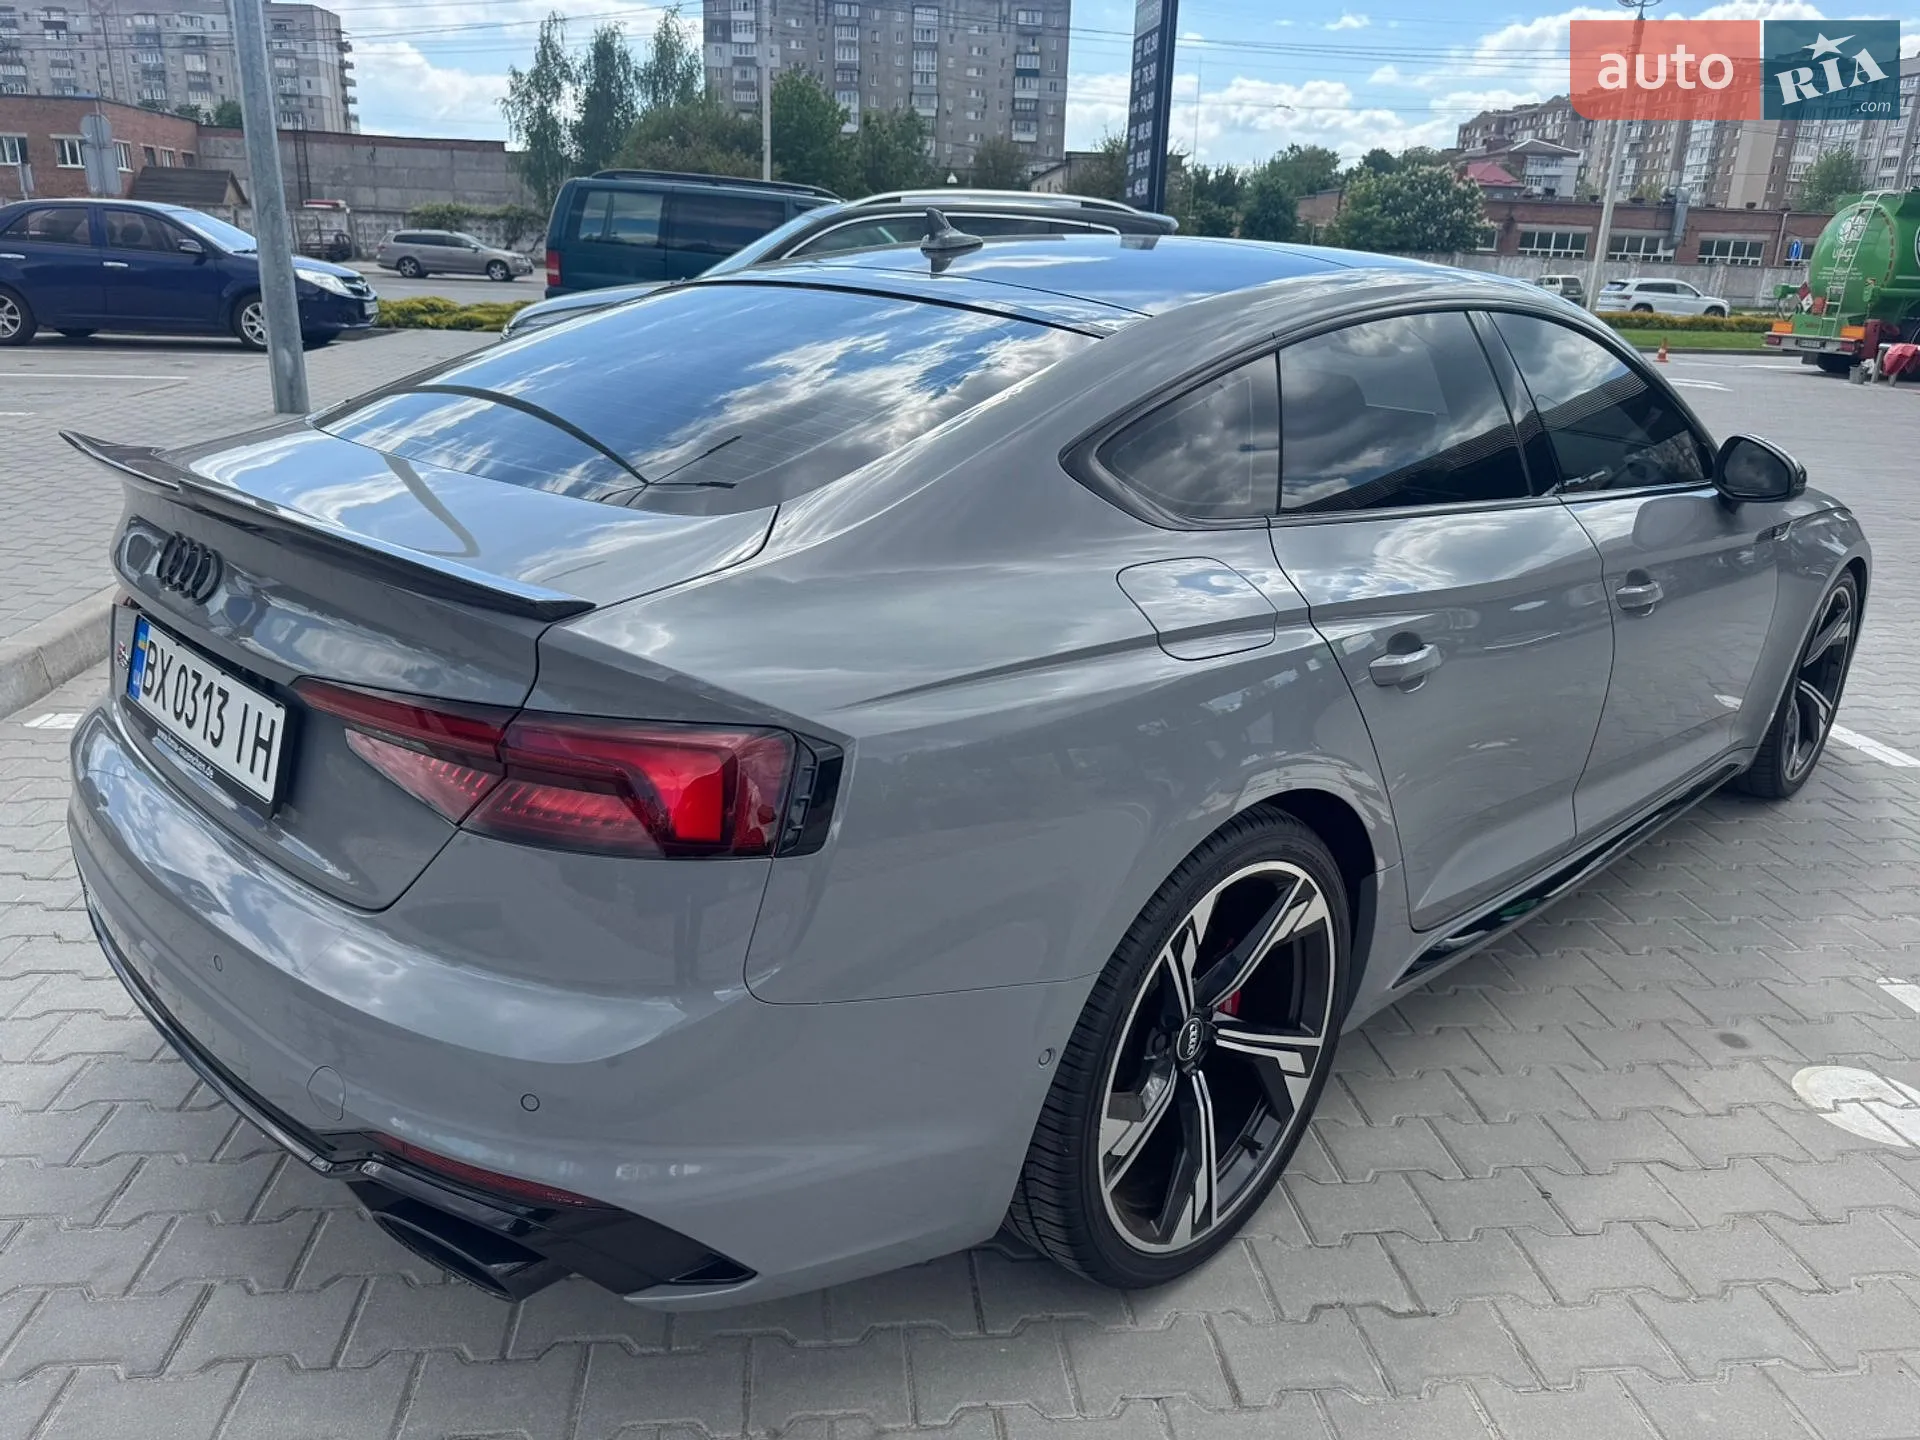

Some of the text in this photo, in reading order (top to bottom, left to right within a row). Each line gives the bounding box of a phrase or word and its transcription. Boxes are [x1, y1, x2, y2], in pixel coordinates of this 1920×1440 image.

[142, 641, 276, 782] BX 0313 IH
